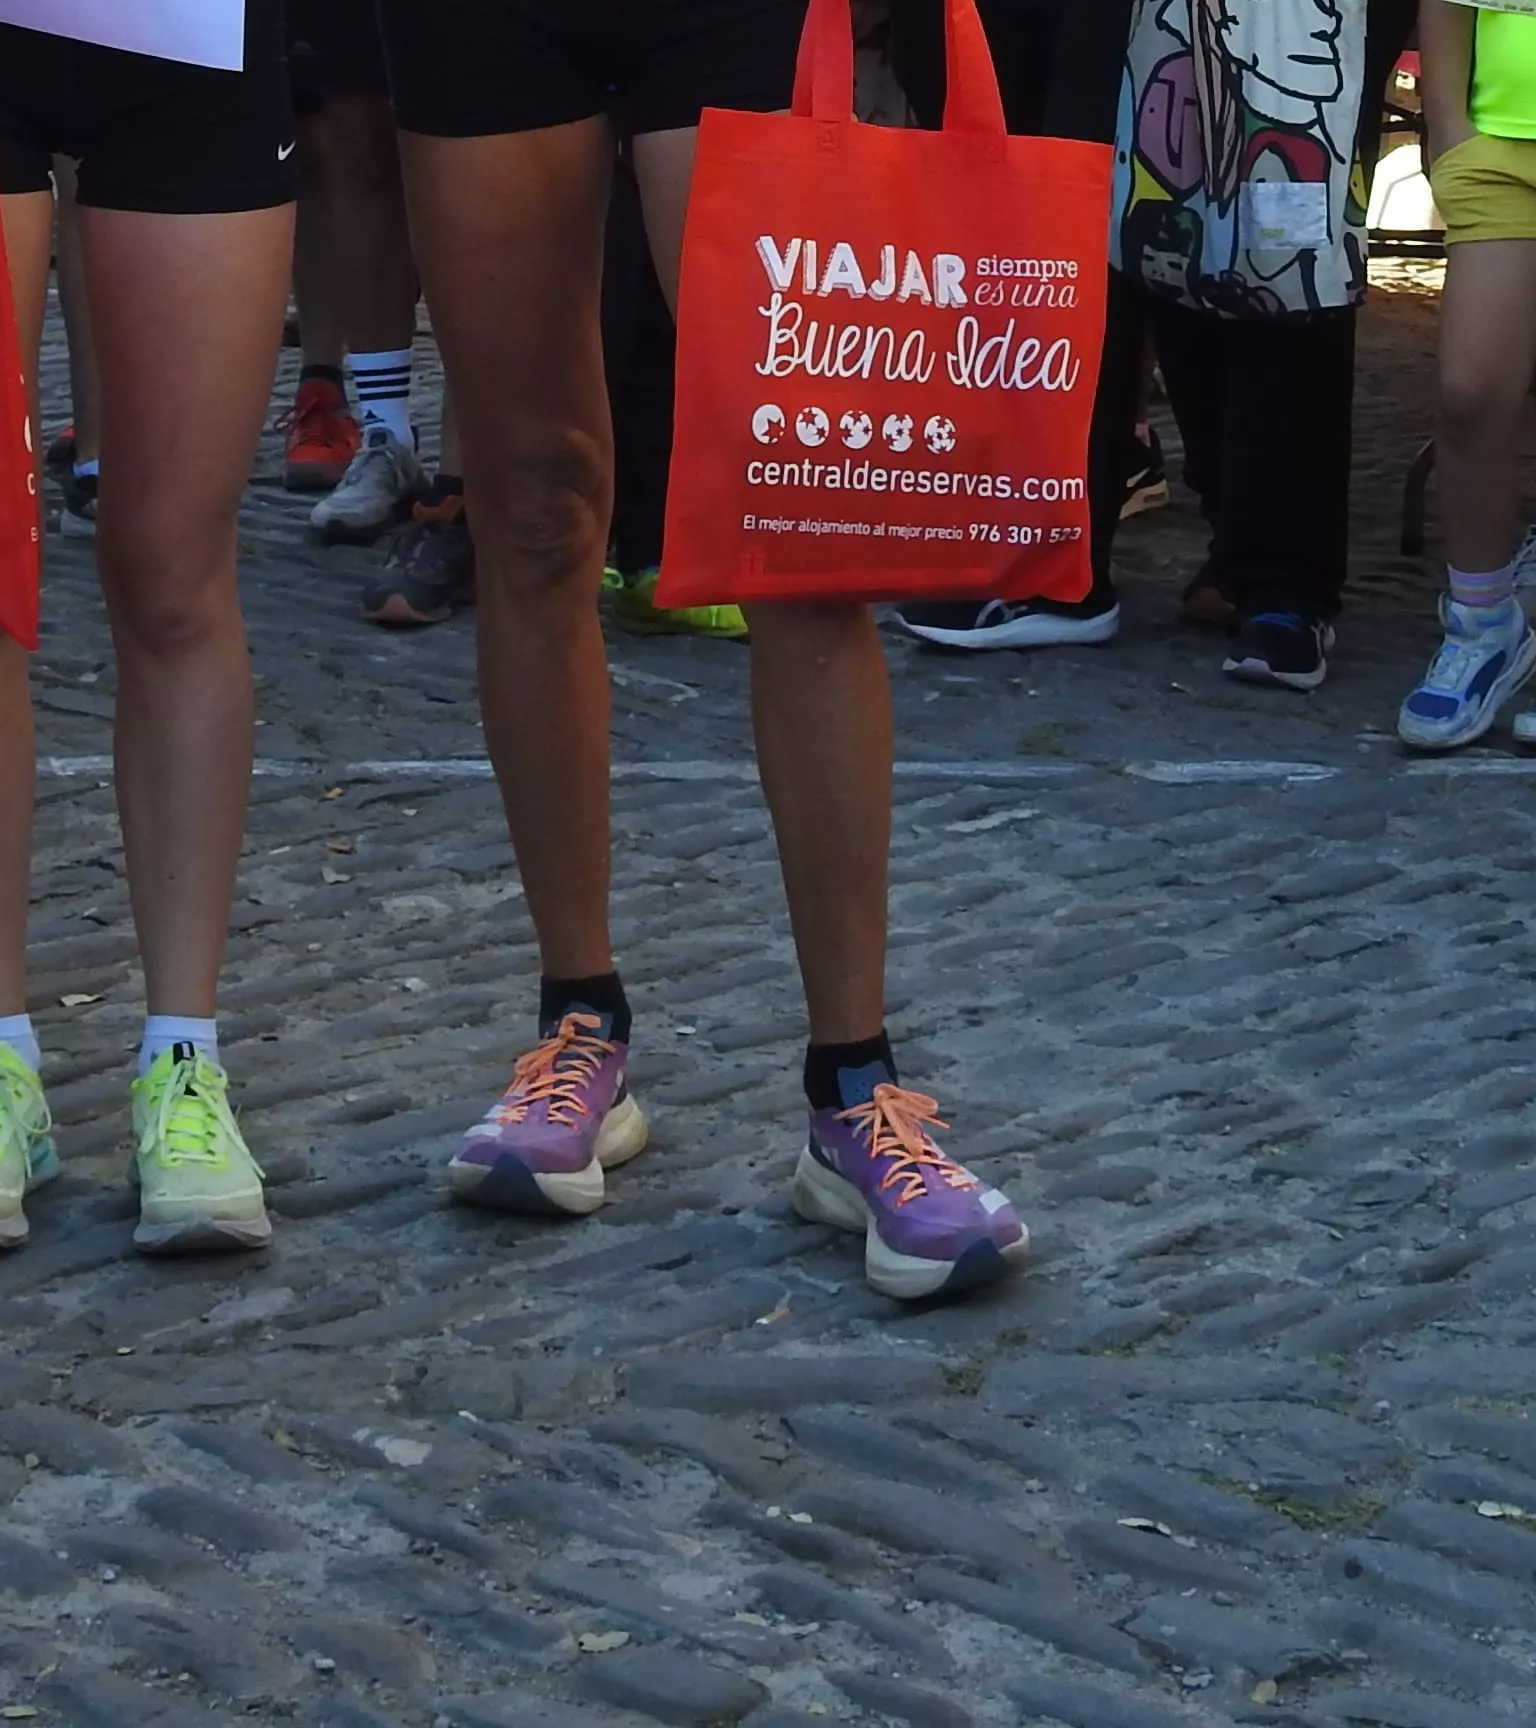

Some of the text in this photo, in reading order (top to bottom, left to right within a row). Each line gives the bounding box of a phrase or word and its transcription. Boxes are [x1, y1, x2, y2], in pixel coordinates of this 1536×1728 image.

[755, 235, 1078, 309] VIAJAR siempre
[975, 281, 1080, 309] es una
[755, 292, 1081, 392] Buena Idea
[746, 458, 1085, 503] centraldereservas.com
[743, 514, 756, 530] El
[759, 516, 795, 534] mejor
[798, 518, 870, 536] alojamiento
[873, 522, 885, 536] al
[888, 523, 922, 541] mejor
[924, 525, 963, 541] precio
[968, 524, 1001, 543] 976
[1007, 525, 1042, 545] 301
